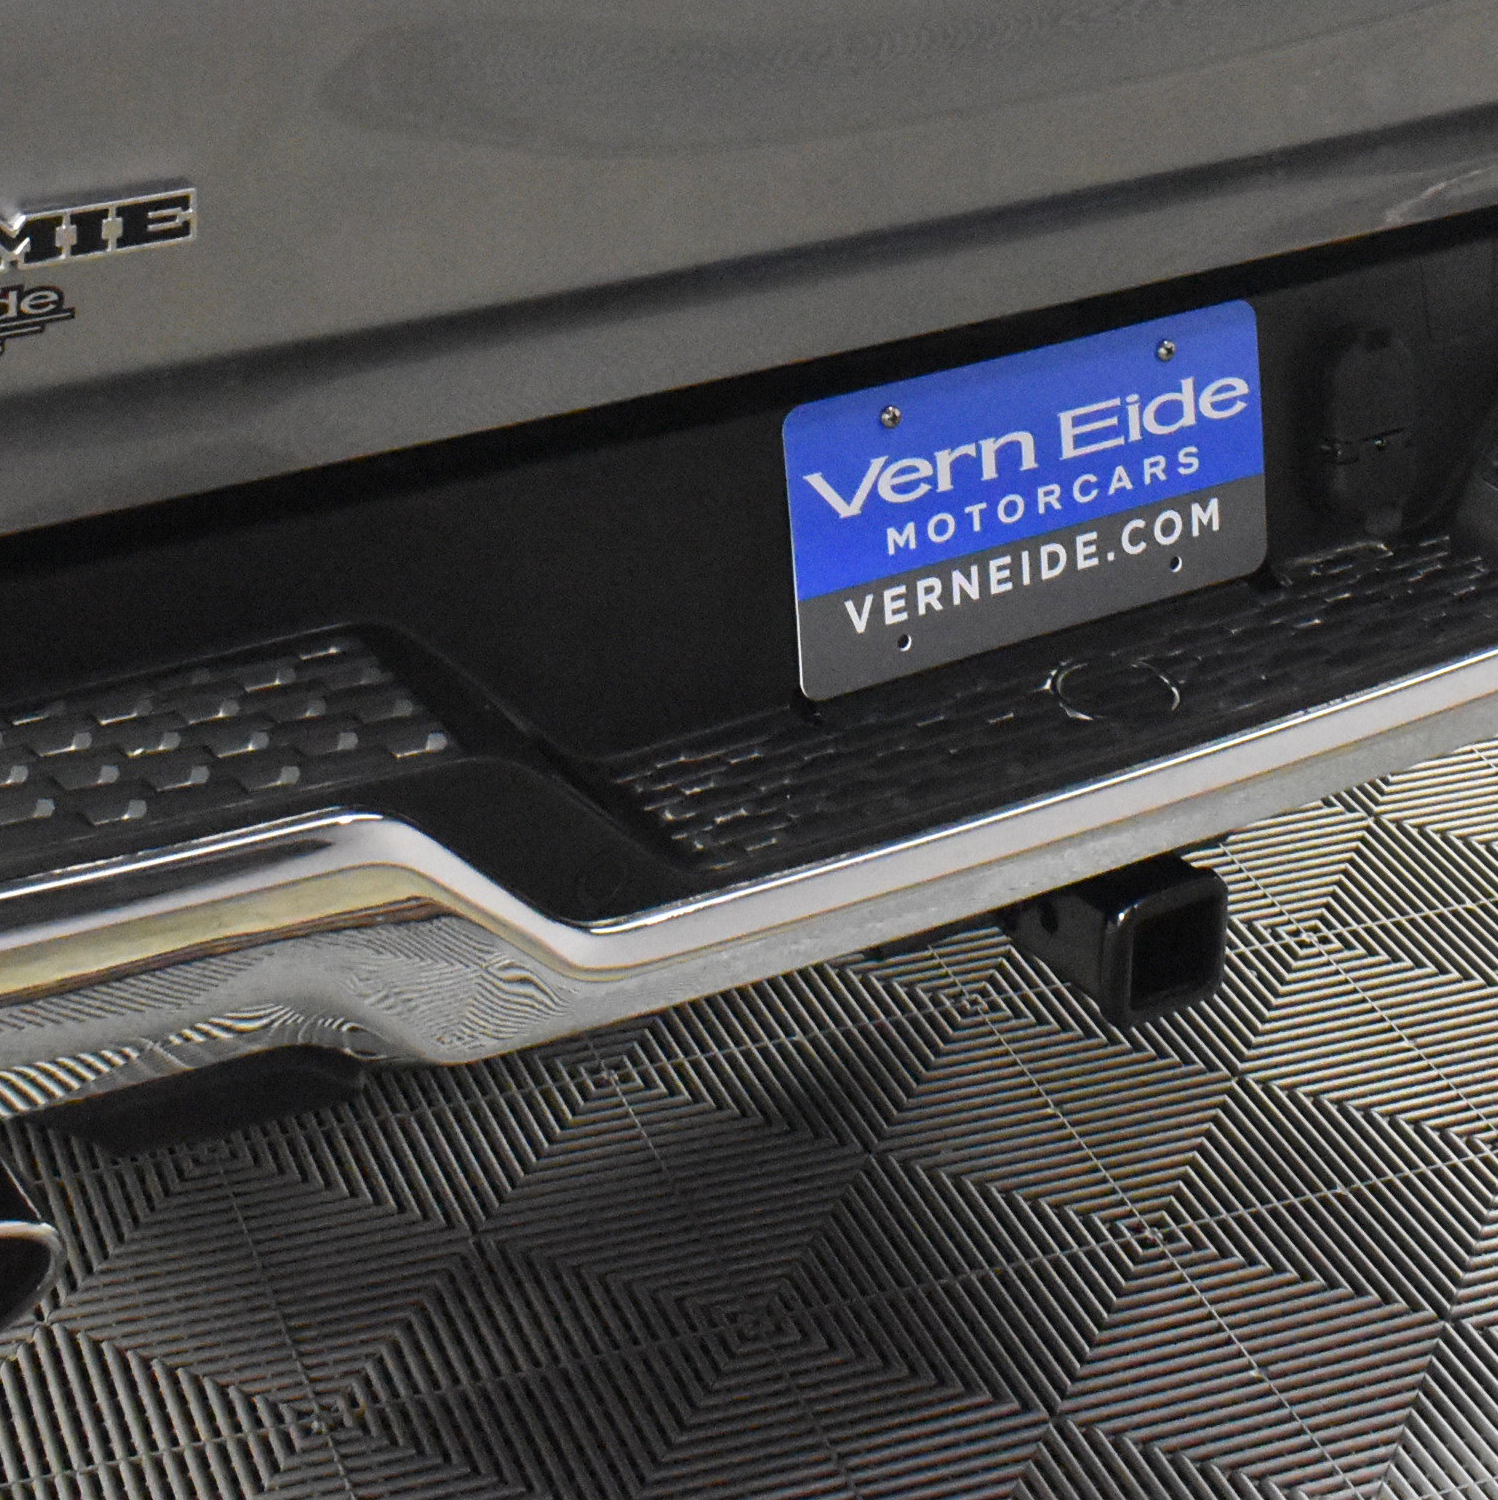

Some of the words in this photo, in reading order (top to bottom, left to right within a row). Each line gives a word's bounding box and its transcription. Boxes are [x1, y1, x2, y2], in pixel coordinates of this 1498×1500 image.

[802, 429, 1038, 519] Vern
[1057, 376, 1250, 461] Eide
[886, 446, 1200, 556] MOTORCARS
[844, 497, 1221, 635] VERNEIDE.COM
